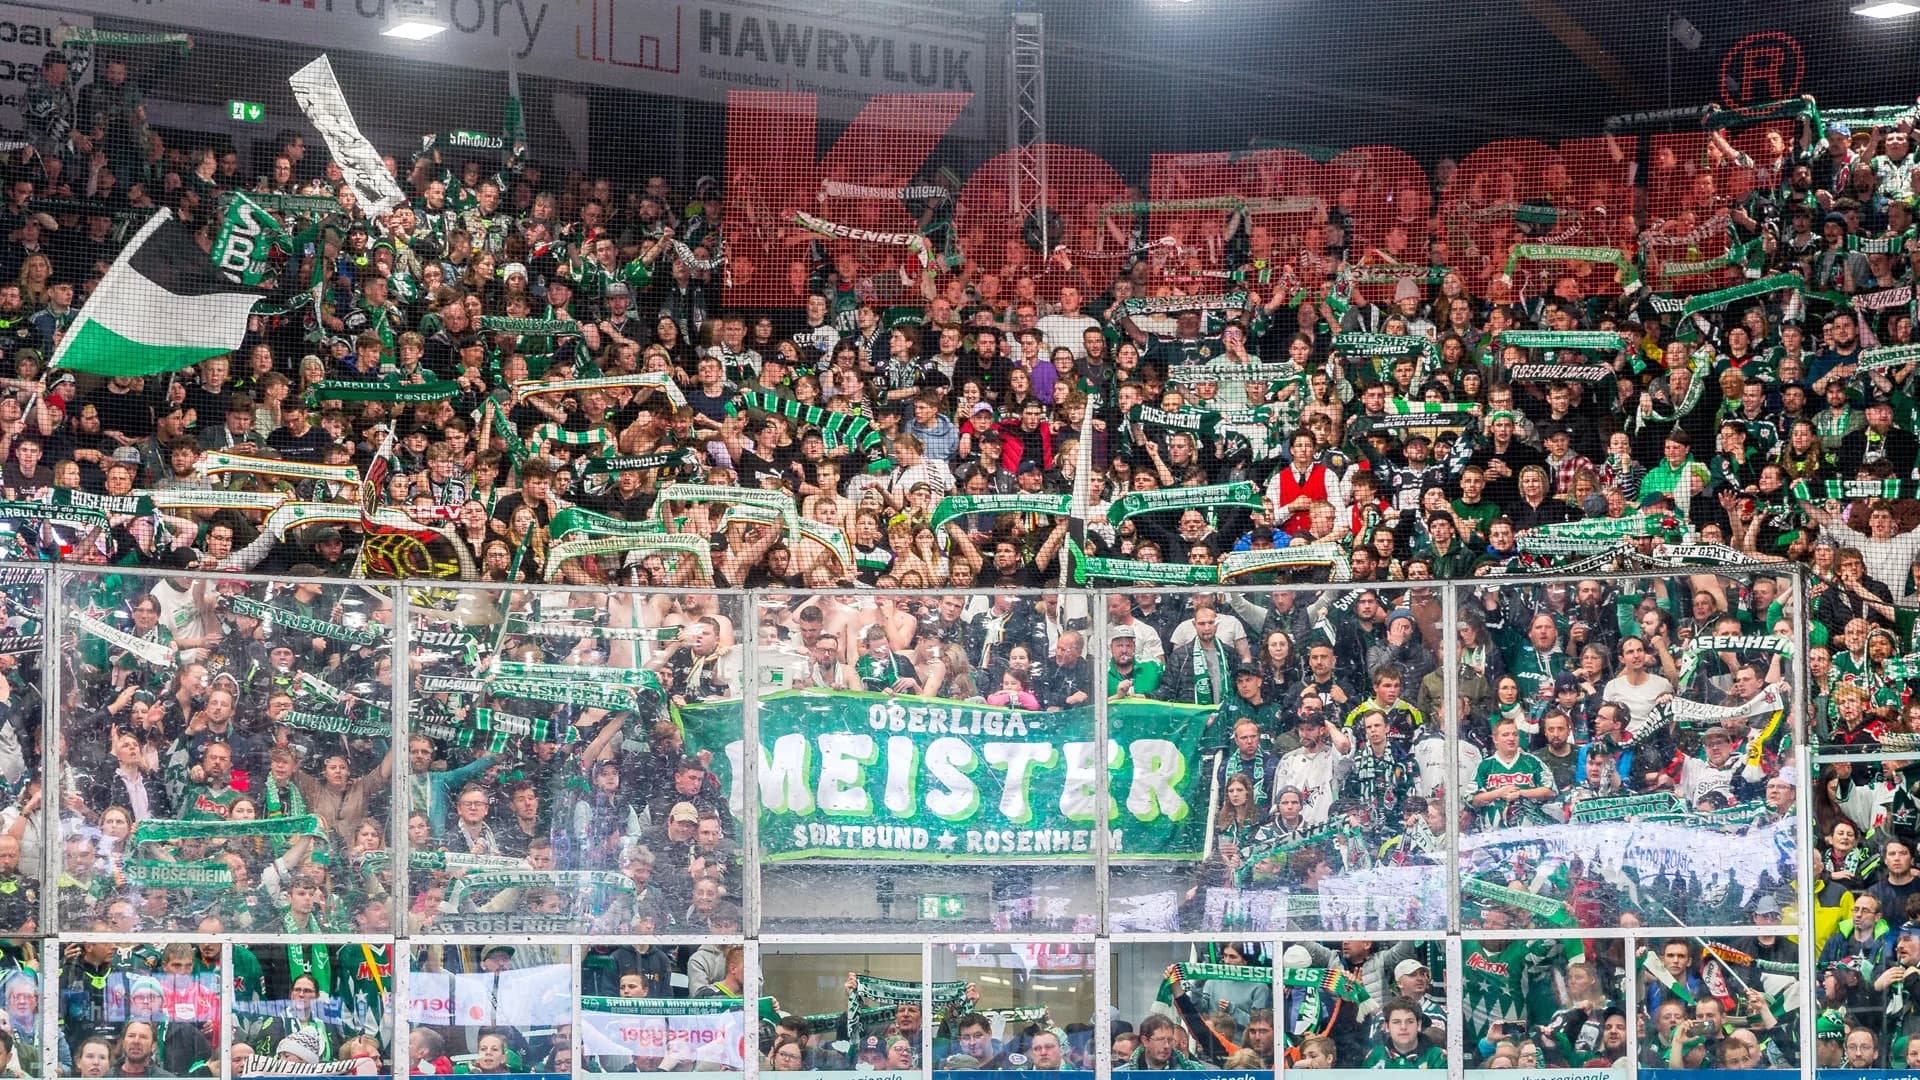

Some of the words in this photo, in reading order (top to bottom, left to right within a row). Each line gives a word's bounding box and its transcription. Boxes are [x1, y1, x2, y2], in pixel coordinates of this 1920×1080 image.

[699, 8, 977, 92] HAWRYLUK
[320, 380, 391, 390] STARBULLS
[1141, 404, 1201, 430] ROSENHEIM
[71, 490, 139, 513] ROSENHEIM
[233, 598, 376, 646] STARBULLS
[869, 704, 1041, 737] OBERLIGA-
[724, 733, 1187, 821] MEISTER
[794, 823, 930, 851] SPORTBUND
[151, 867, 233, 883] ROSENHEIM
